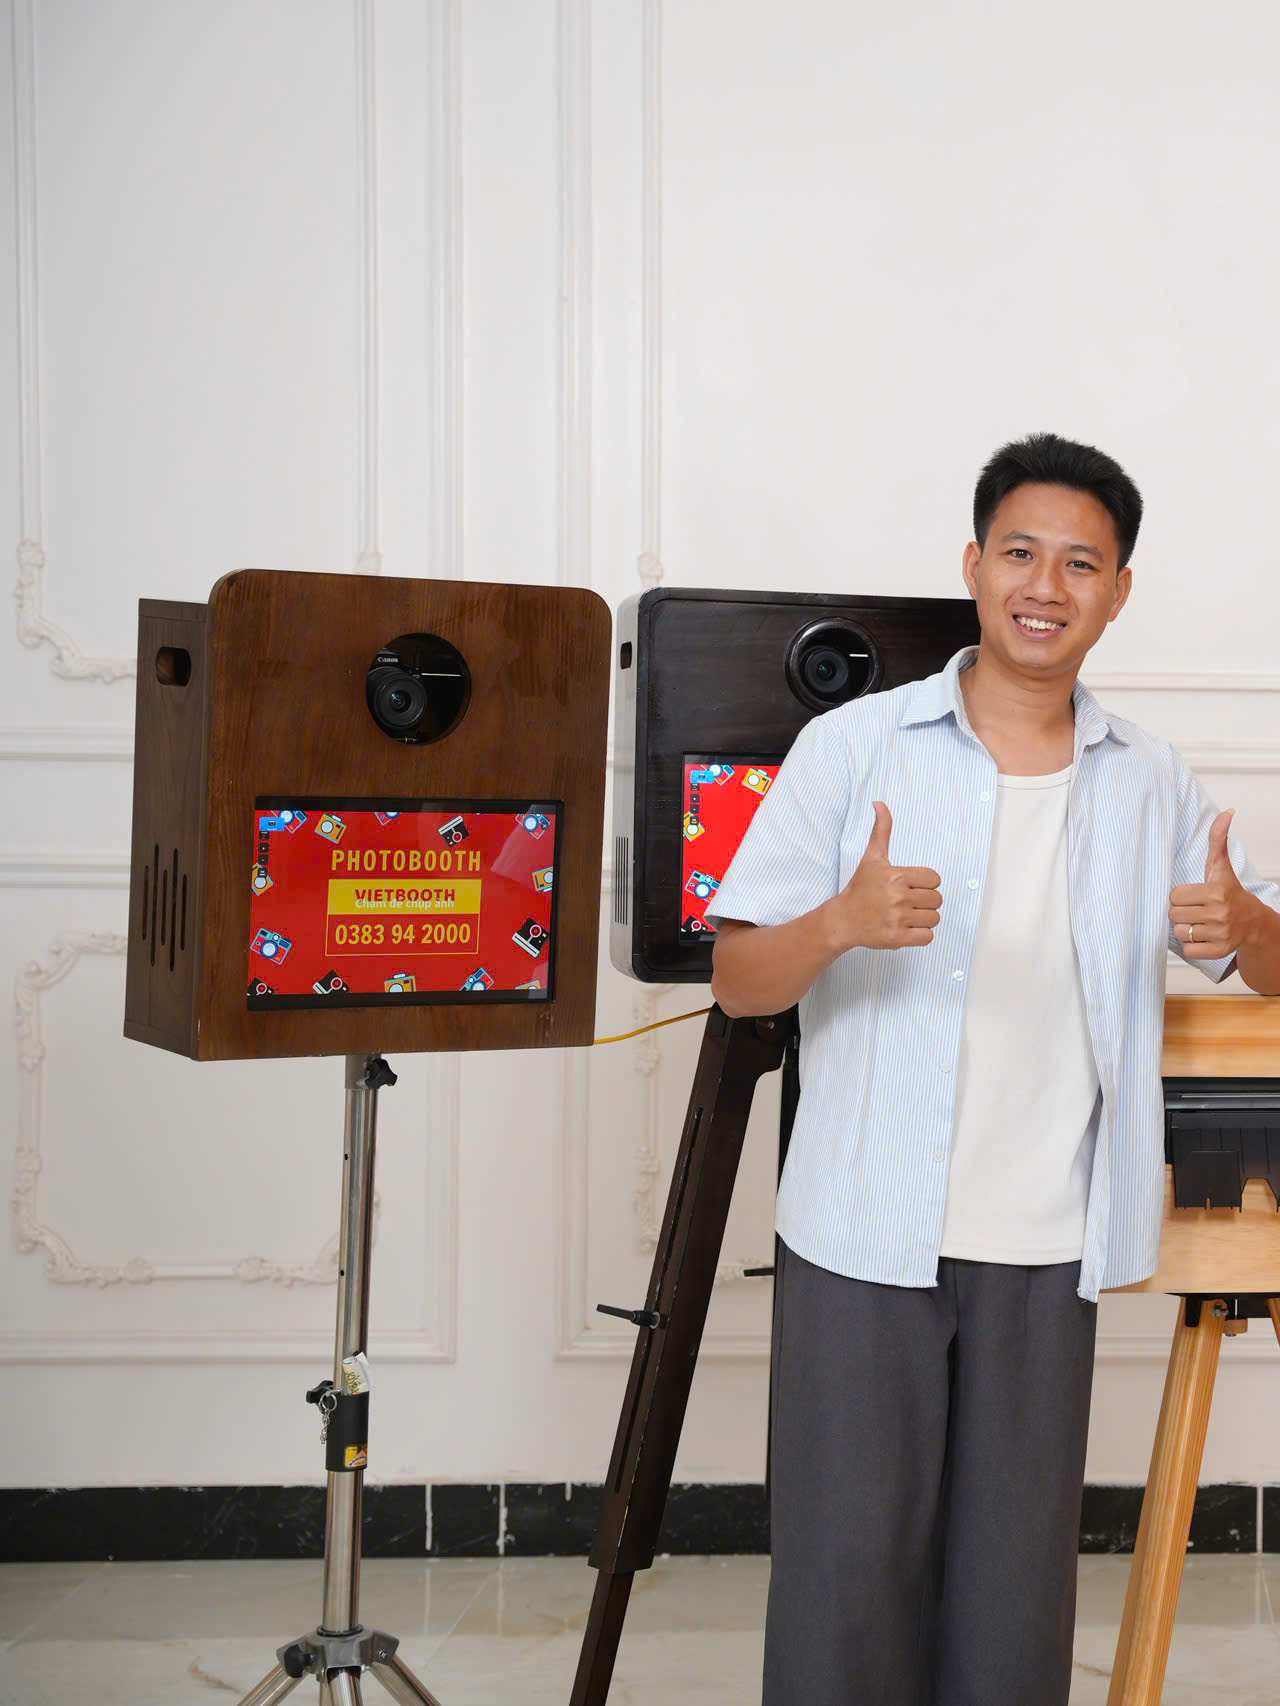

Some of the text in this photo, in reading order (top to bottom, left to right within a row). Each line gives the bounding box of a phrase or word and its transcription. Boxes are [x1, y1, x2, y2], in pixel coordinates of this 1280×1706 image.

[331, 849, 481, 872] PHOTOBOOTH
[354, 888, 457, 902] VIETBOOTH
[335, 923, 472, 945] 0383 94 2000
